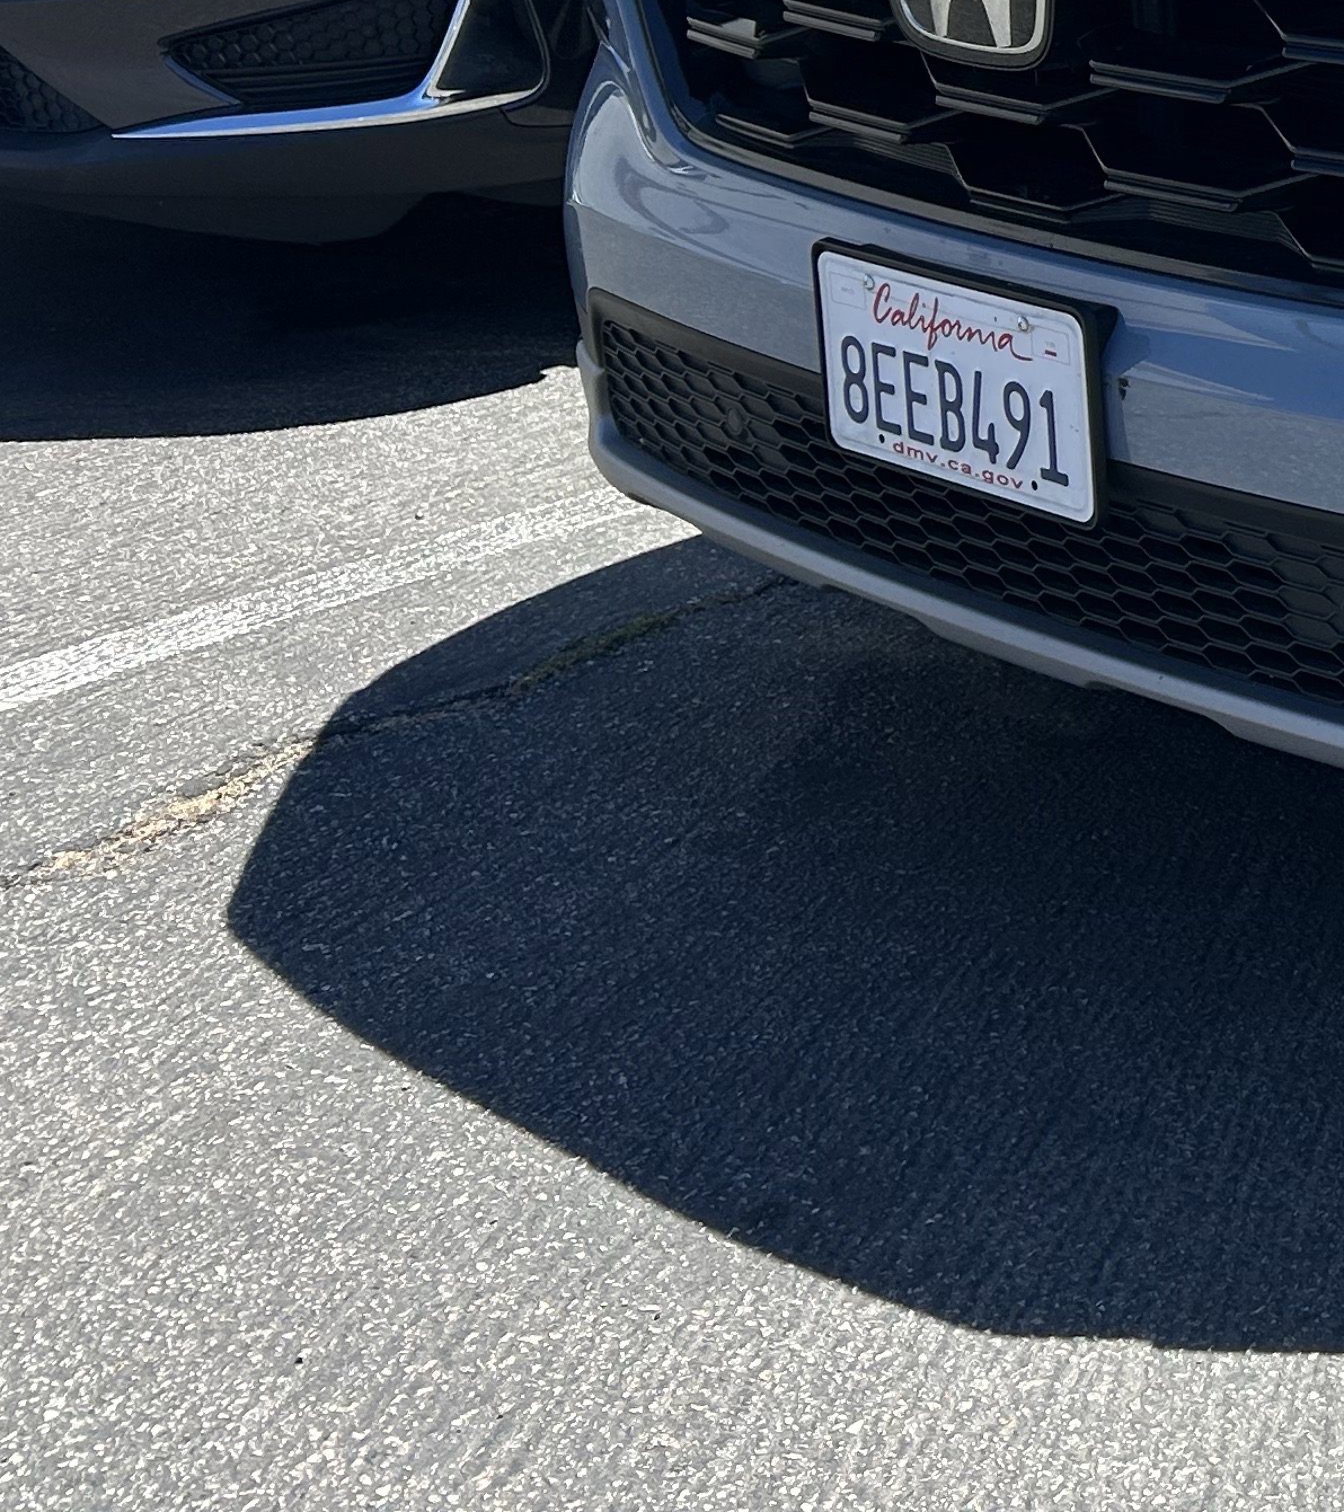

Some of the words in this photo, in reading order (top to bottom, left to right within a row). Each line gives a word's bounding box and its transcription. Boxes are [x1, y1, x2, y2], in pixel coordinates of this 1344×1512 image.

[872, 282, 1034, 362] California
[841, 335, 1070, 487] 8EEB491
[892, 440, 1024, 490] dmv.ca.gov
